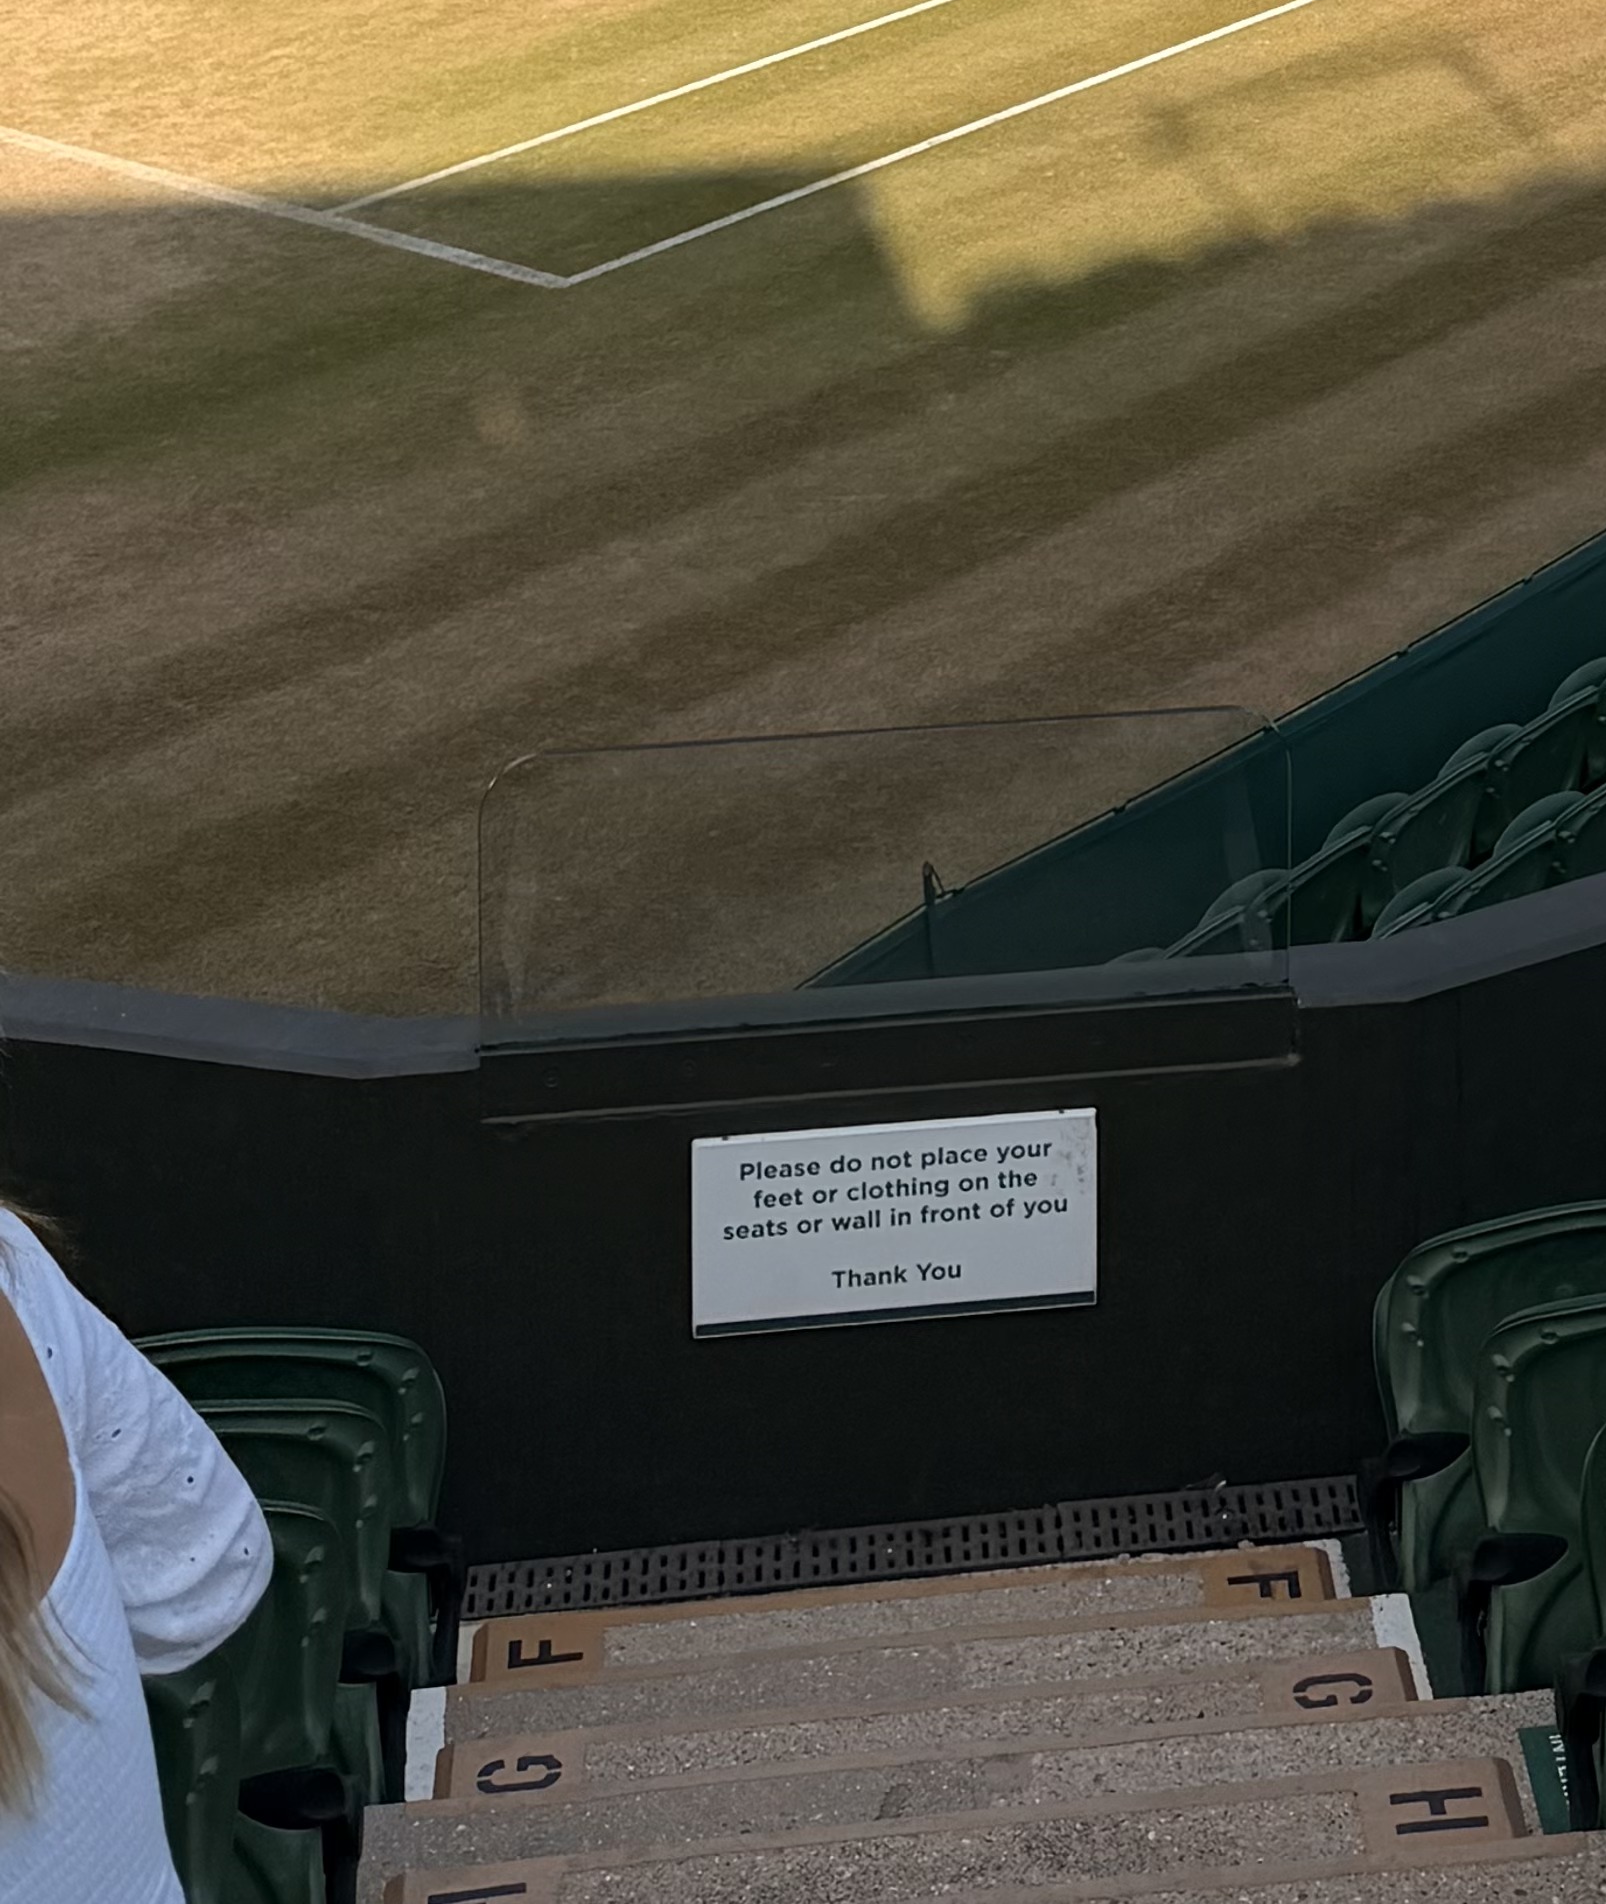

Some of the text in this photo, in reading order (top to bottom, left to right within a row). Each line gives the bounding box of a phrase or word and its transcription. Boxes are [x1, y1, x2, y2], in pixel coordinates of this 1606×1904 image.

[740, 1143, 1053, 1181] Please do not place your
[754, 1170, 1037, 1208] feet or clothing on the
[723, 1198, 1067, 1241] seats or wall in front of you
[831, 1263, 961, 1288] Thank You
[1227, 1571, 1302, 1599] F
[508, 1640, 583, 1669] F
[1293, 1673, 1373, 1709] G
[477, 1755, 562, 1794] G
[1390, 1787, 1489, 1835] H
